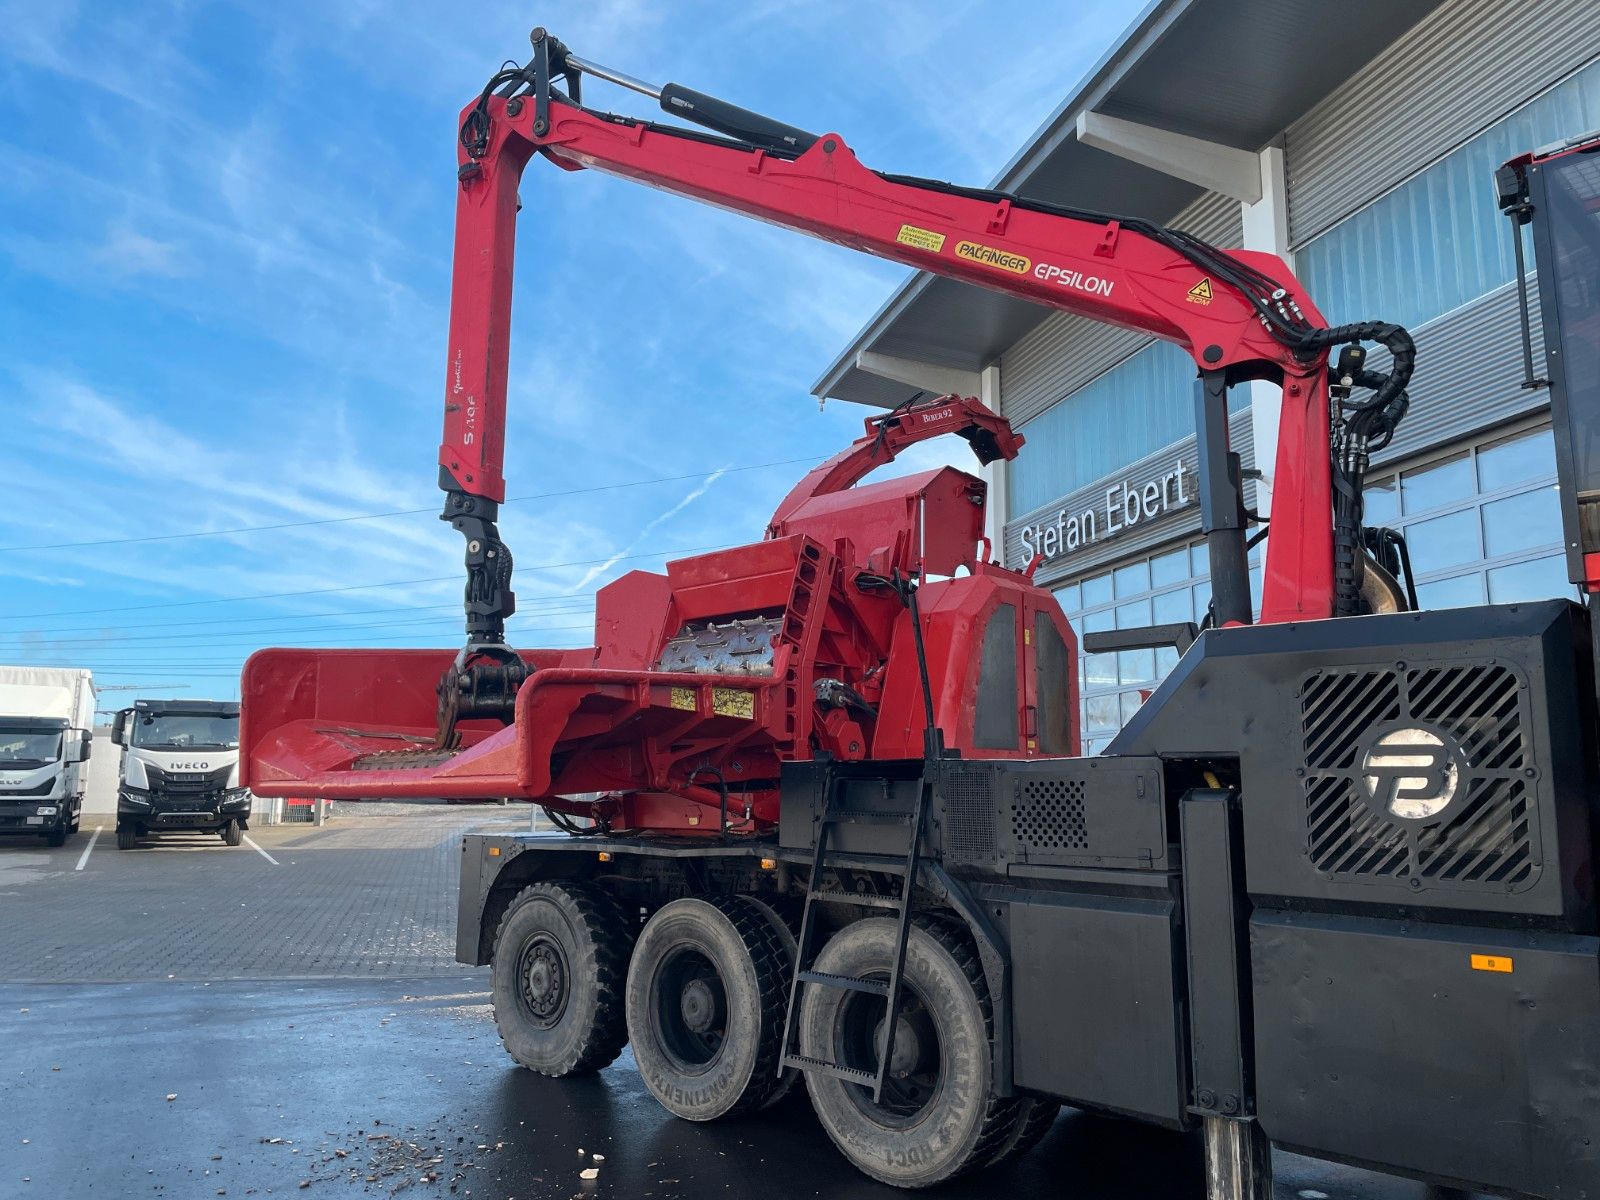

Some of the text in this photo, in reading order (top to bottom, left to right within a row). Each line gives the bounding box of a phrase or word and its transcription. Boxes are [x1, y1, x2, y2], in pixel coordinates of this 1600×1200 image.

[959, 243, 1114, 297] PALFINGER EPSILON
[1020, 459, 1189, 566] Stefan Ebert
[170, 762, 209, 770] IVECO
